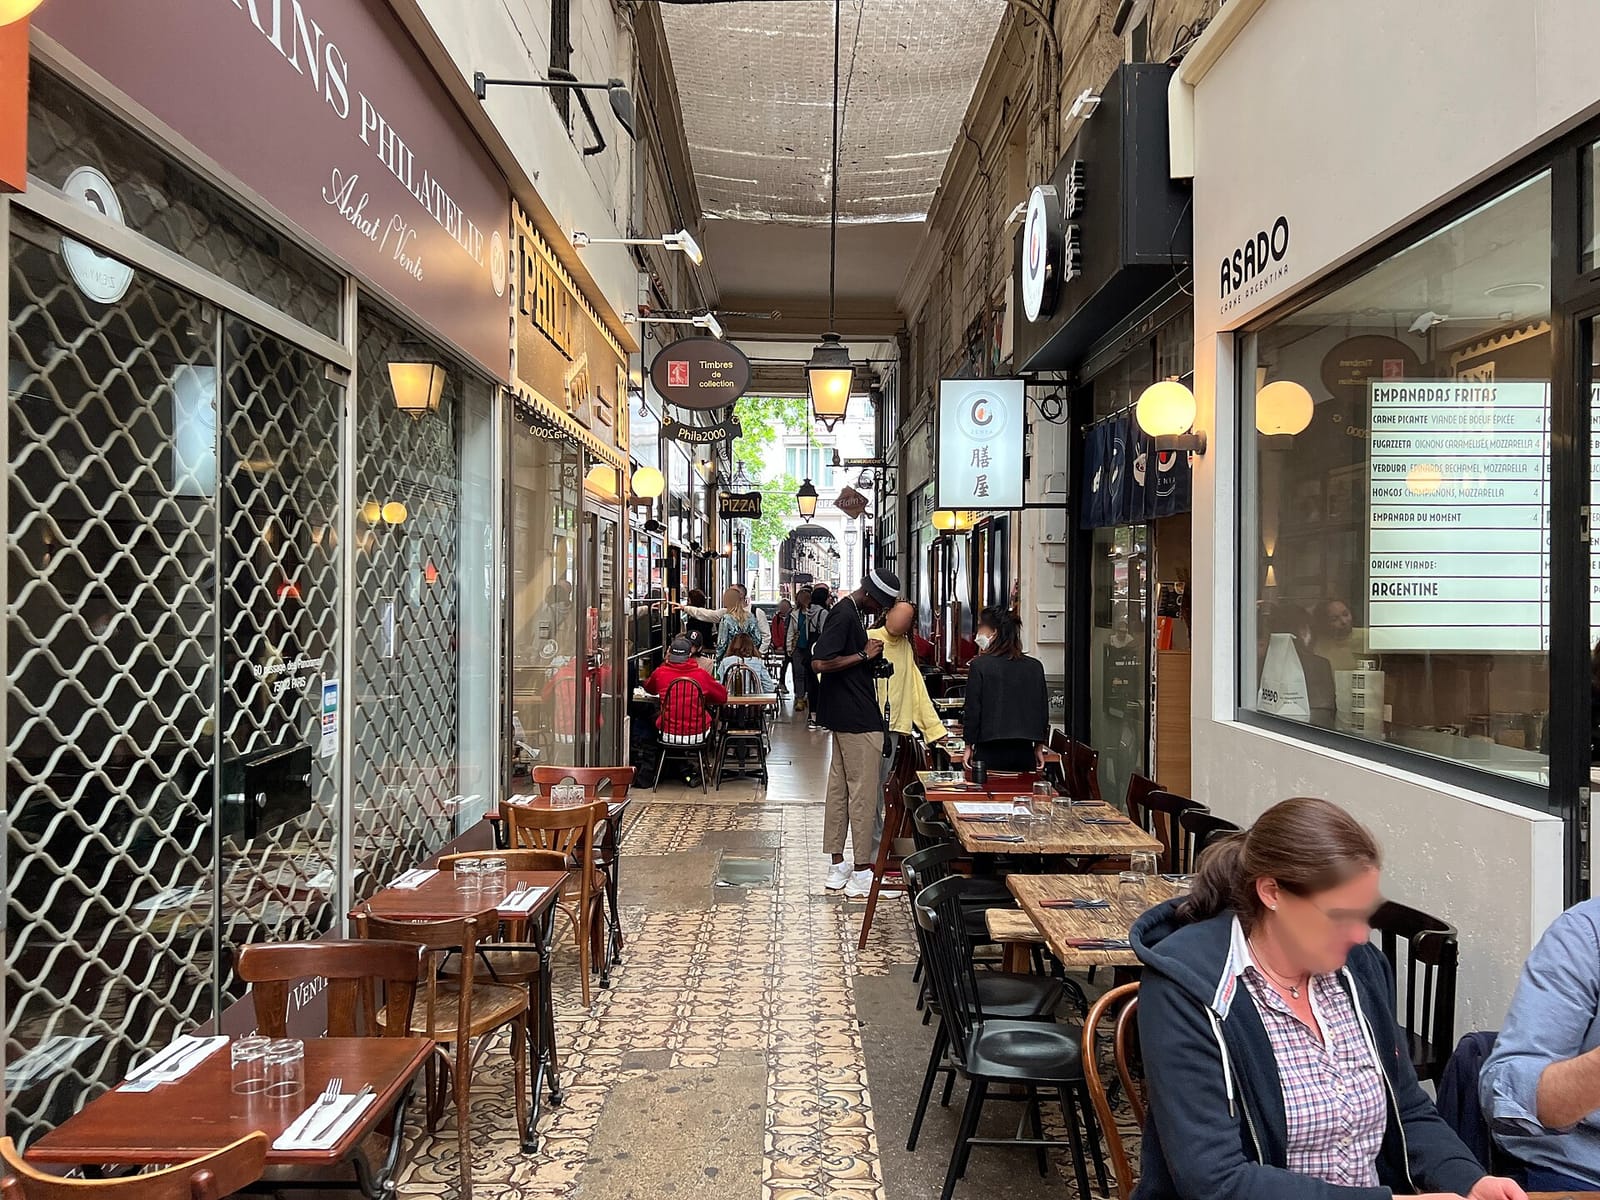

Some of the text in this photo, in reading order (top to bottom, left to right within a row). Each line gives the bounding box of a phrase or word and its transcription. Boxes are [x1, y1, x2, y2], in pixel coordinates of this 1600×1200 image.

[231, 0, 485, 268] INS PHILATELIE
[322, 168, 381, 242] Achat
[1220, 215, 1289, 299] ASADO
[1245, 263, 1289, 298] ARGENTINA
[698, 360, 734, 369] Timbres
[698, 379, 735, 388] collection
[1373, 388, 1497, 402] EMPANADAS FRITAS
[1372, 415, 1397, 424] CARNE
[1397, 415, 1428, 424] PICANTE
[1431, 415, 1457, 425] VIANDE
[1458, 415, 1468, 425] DE
[1535, 415, 1541, 424] 4
[677, 427, 727, 442] Phila2000
[1372, 440, 1412, 449] FUGAZZETA
[1414, 439, 1443, 449] OIGNONS
[1489, 439, 1533, 449] MOZZARELLA
[1534, 440, 1541, 449] 4
[970, 445, 993, 498] 膳屋
[1372, 464, 1407, 473] VERDURA
[1483, 463, 1528, 473] MOZZARELLA
[1533, 464, 1539, 473] 4
[1372, 488, 1539, 499] HONGOS CHAMPIGNONS, MOZZARELLA 4
[722, 499, 756, 512] PIZZA
[1373, 512, 1538, 522] EMPANADA DU MOMENT 4
[1371, 560, 1438, 570] ORIGINE VIANDE:
[1371, 582, 1439, 597] ARGENTINE
